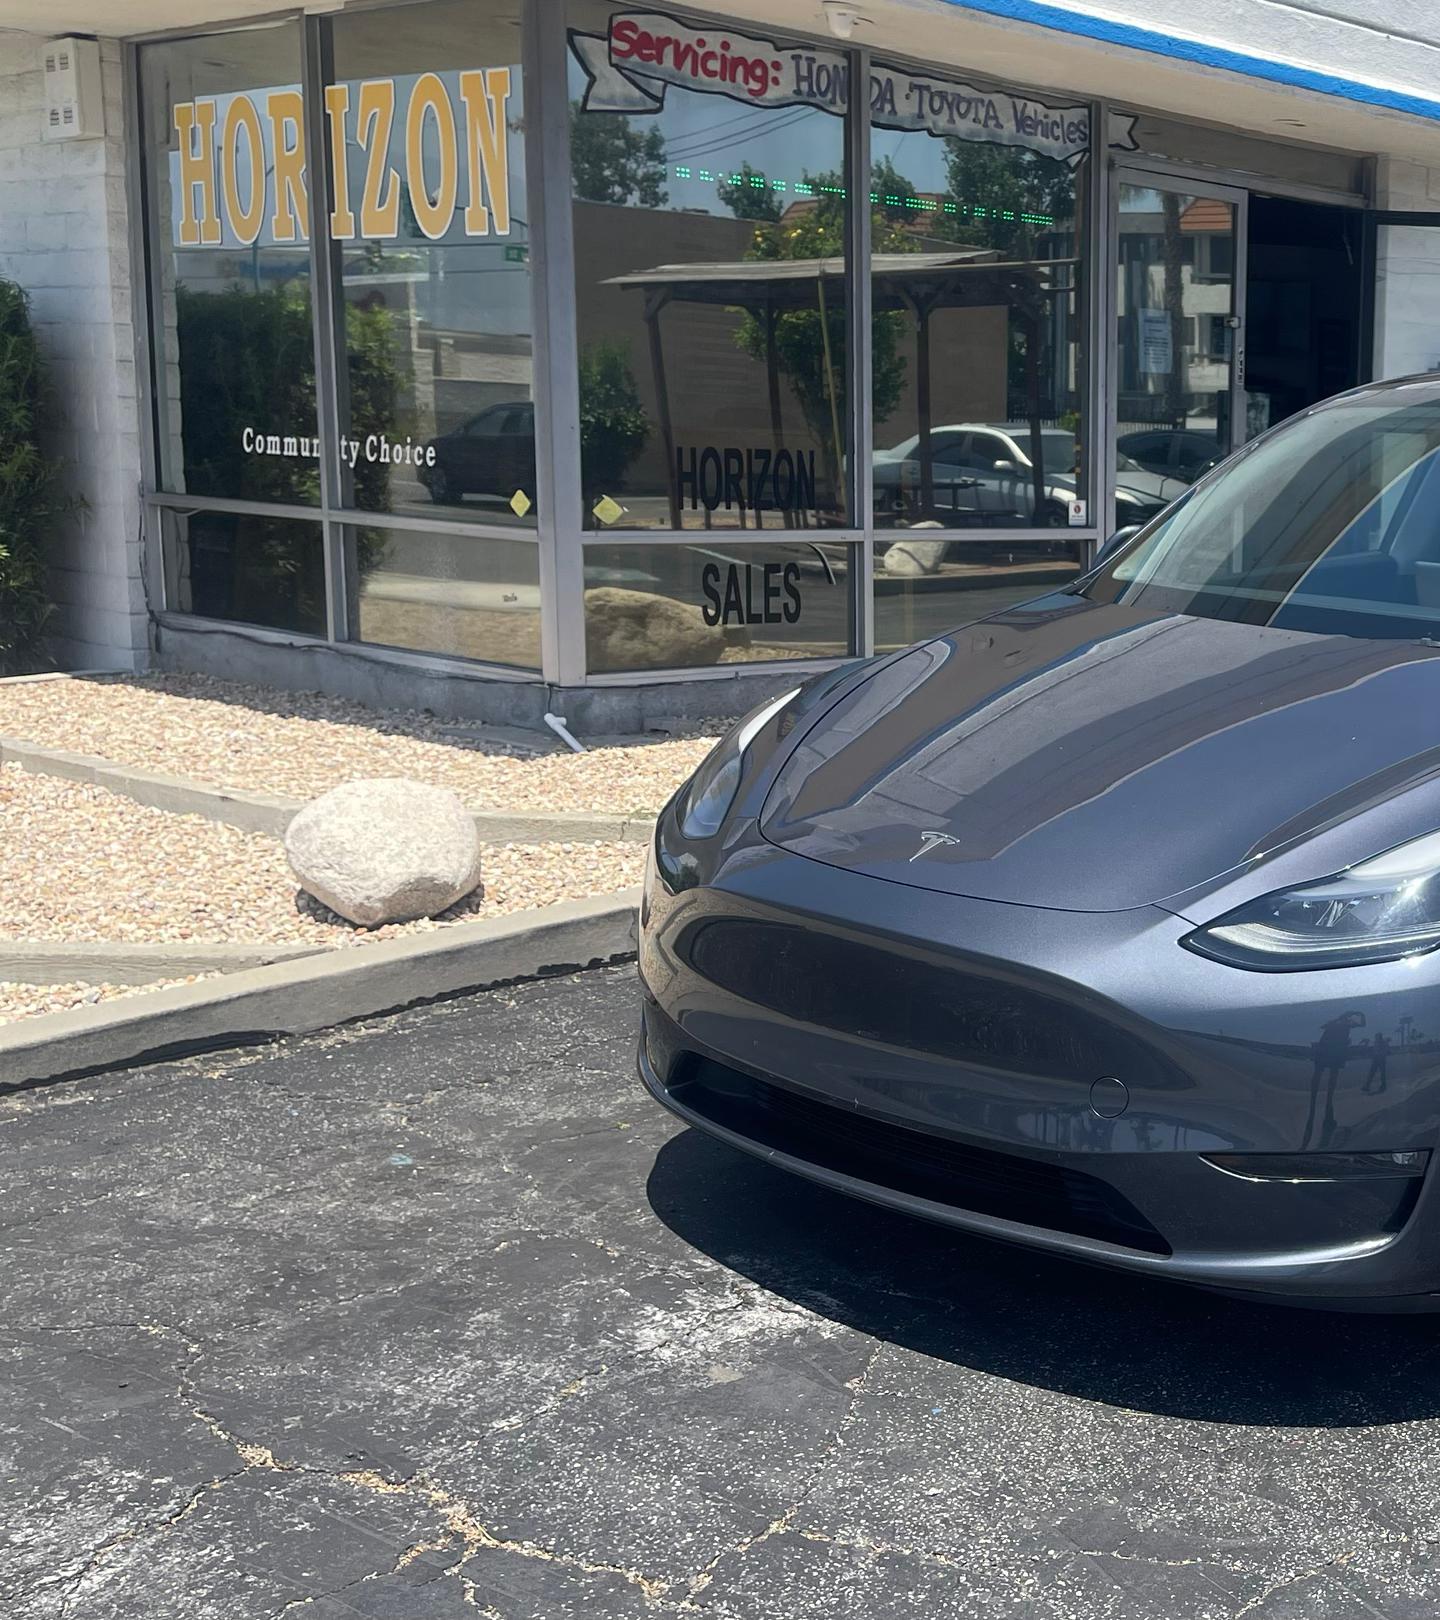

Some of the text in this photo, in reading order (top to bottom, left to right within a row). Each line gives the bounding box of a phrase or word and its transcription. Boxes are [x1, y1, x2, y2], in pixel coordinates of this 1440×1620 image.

[612, 20, 783, 97] Servicing:
[1012, 101, 1088, 144] Vehicles
[173, 67, 511, 245] HORIZON
[242, 427, 436, 468] Communty Choice
[676, 446, 815, 510] HORIZON
[702, 562, 801, 626] SALES
